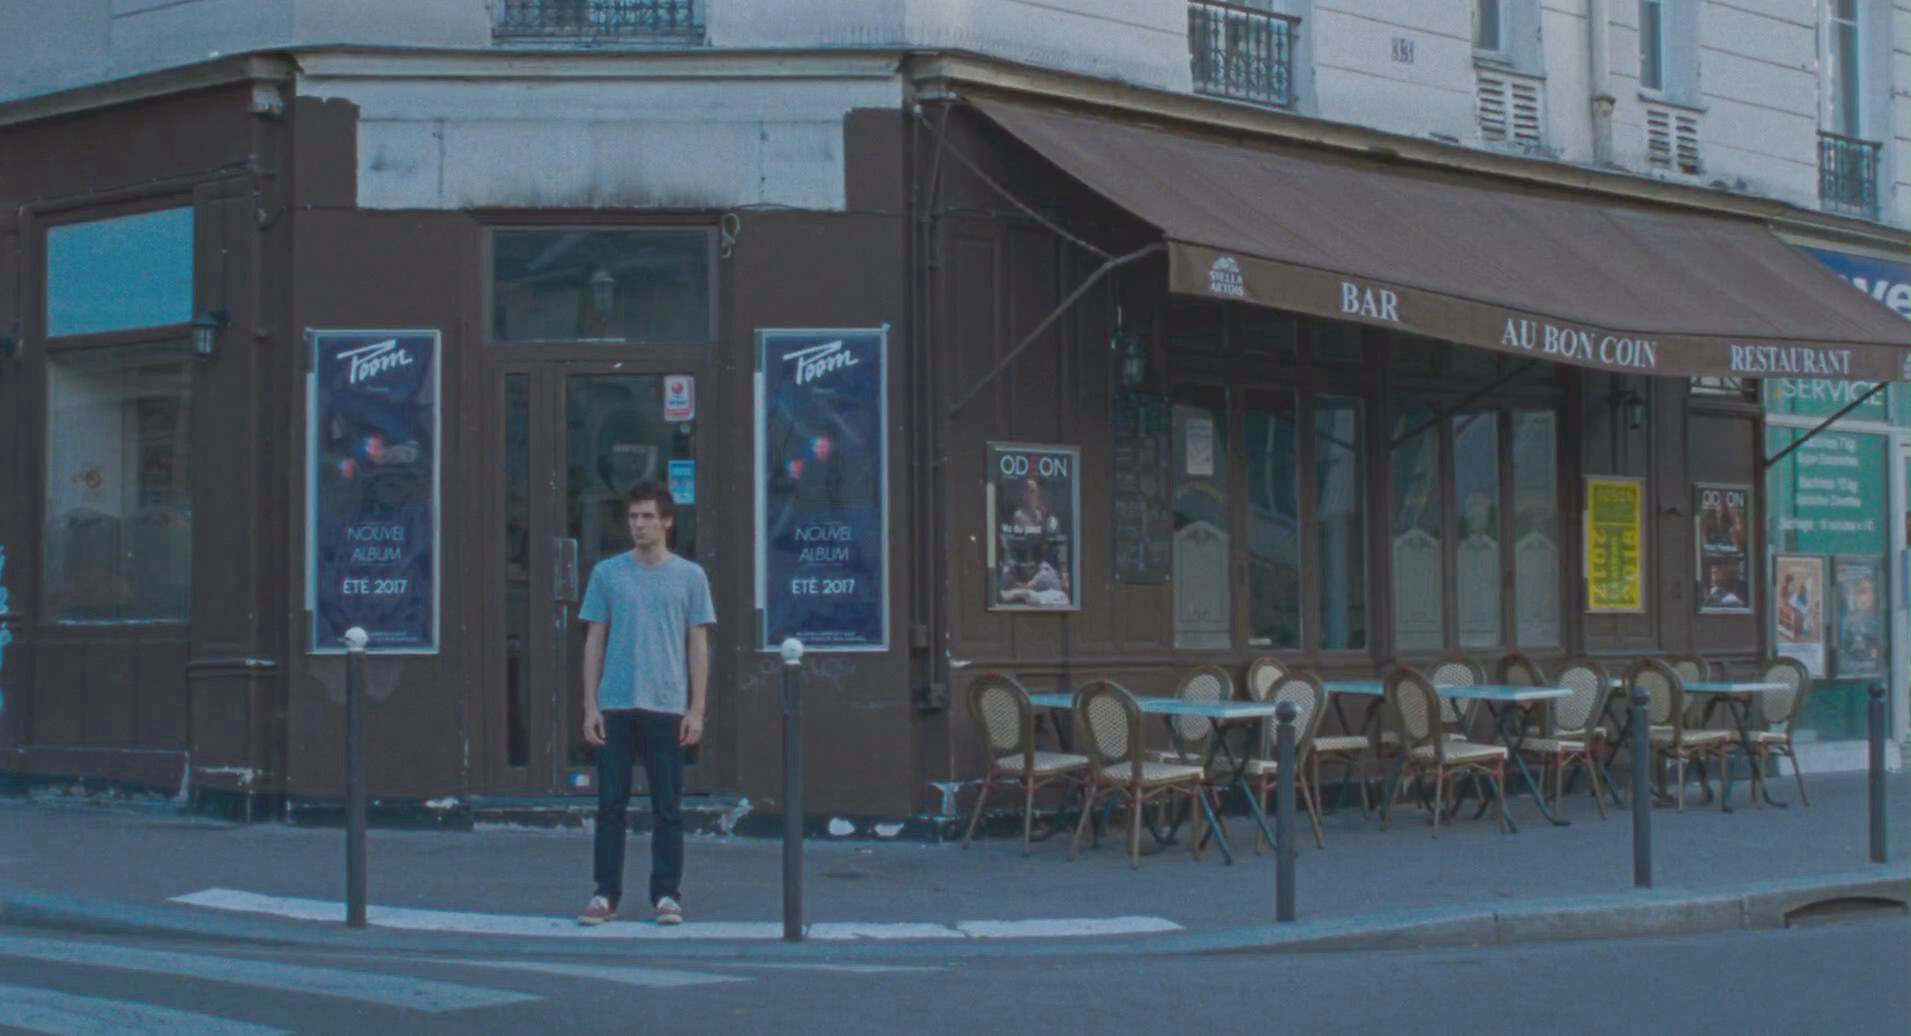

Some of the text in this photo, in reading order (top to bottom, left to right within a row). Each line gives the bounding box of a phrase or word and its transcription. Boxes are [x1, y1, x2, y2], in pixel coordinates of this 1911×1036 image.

[1341, 281, 1400, 322] BAR
[1501, 318, 1657, 368] AU BON COIN
[1730, 344, 1853, 375] RESTAURANT
[1781, 378, 1885, 405] SERVICE
[347, 526, 405, 540] NOUVEL
[795, 526, 852, 540] NOUVEL
[352, 546, 401, 561] ALBUM
[800, 546, 849, 561] ALBUM
[343, 576, 409, 594] ÉTÉ 2017
[792, 576, 856, 594] ÉTÉ 2017
